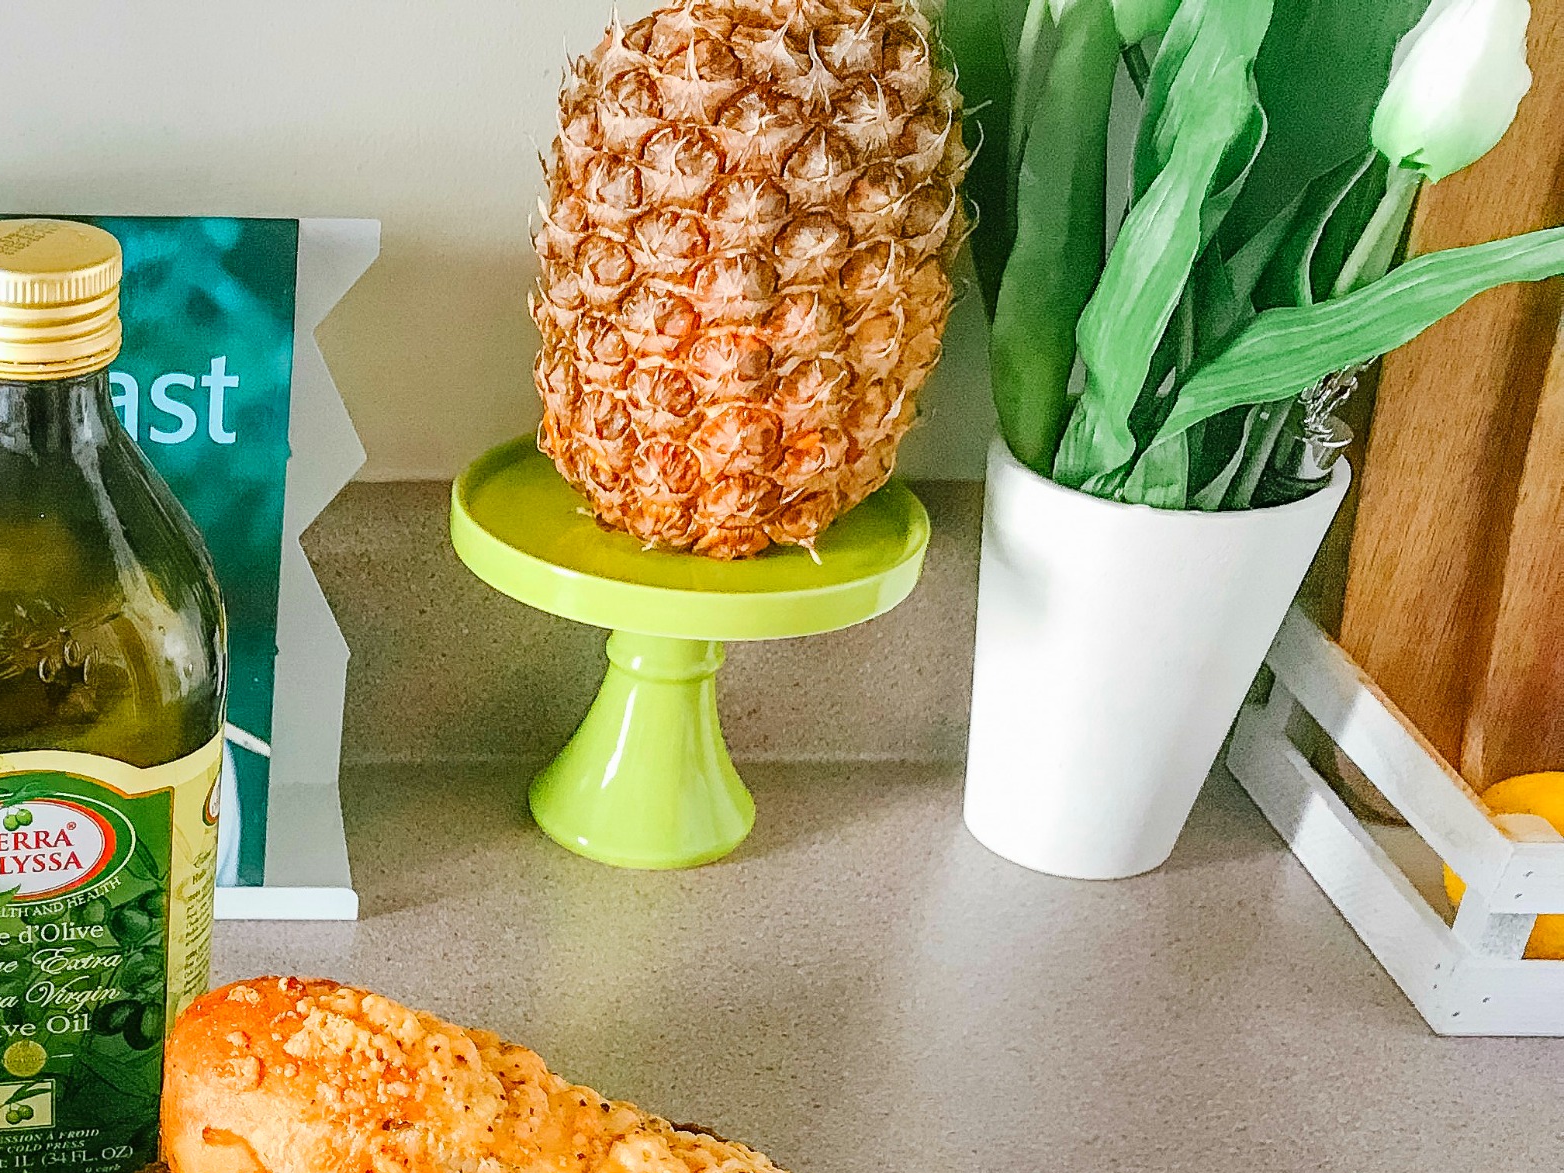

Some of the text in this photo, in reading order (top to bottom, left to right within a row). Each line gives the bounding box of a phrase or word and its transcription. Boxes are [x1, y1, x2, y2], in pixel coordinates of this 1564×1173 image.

[109, 355, 239, 444] ast
[32, 902, 64, 917] AND
[67, 875, 122, 910] HEALTH
[18, 922, 104, 945] d'Olive
[32, 947, 123, 974] Extra
[26, 975, 122, 1014] Virgin
[46, 1013, 91, 1034] Oil
[7, 1143, 42, 1154] COLD
[46, 1140, 86, 1151] PRESS
[101, 1145, 134, 1160] OZ)
